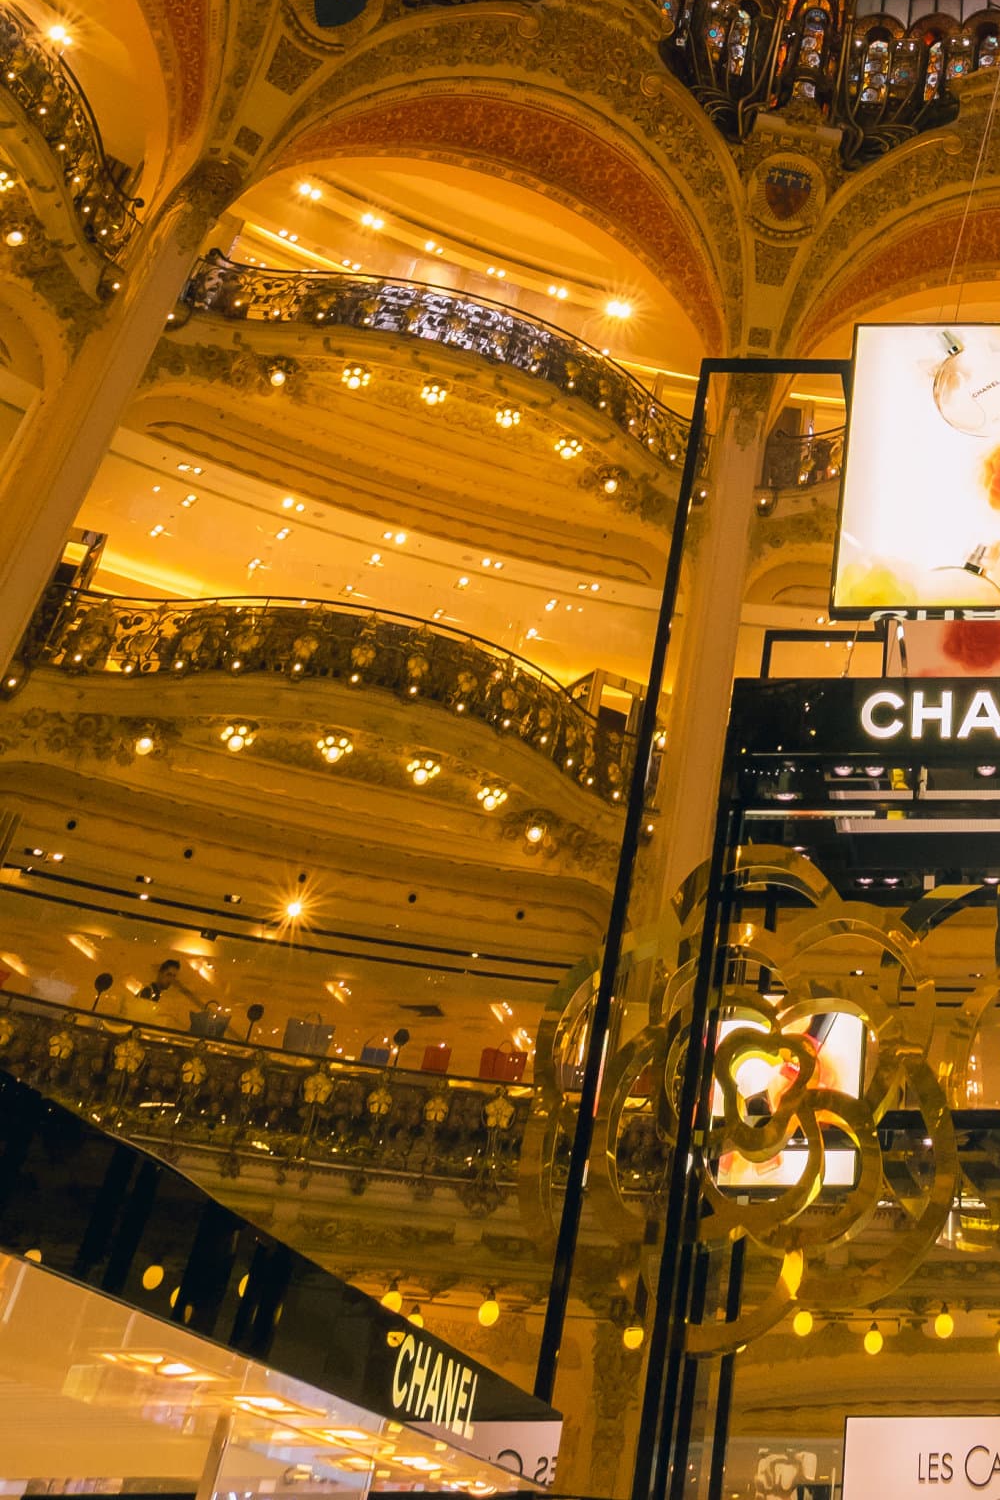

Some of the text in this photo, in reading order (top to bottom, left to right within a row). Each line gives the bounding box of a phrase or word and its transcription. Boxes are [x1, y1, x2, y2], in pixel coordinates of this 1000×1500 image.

[971, 380, 1000, 399] CHANEL
[392, 1334, 478, 1441] CHANEL
[918, 1452, 954, 1483] LES
